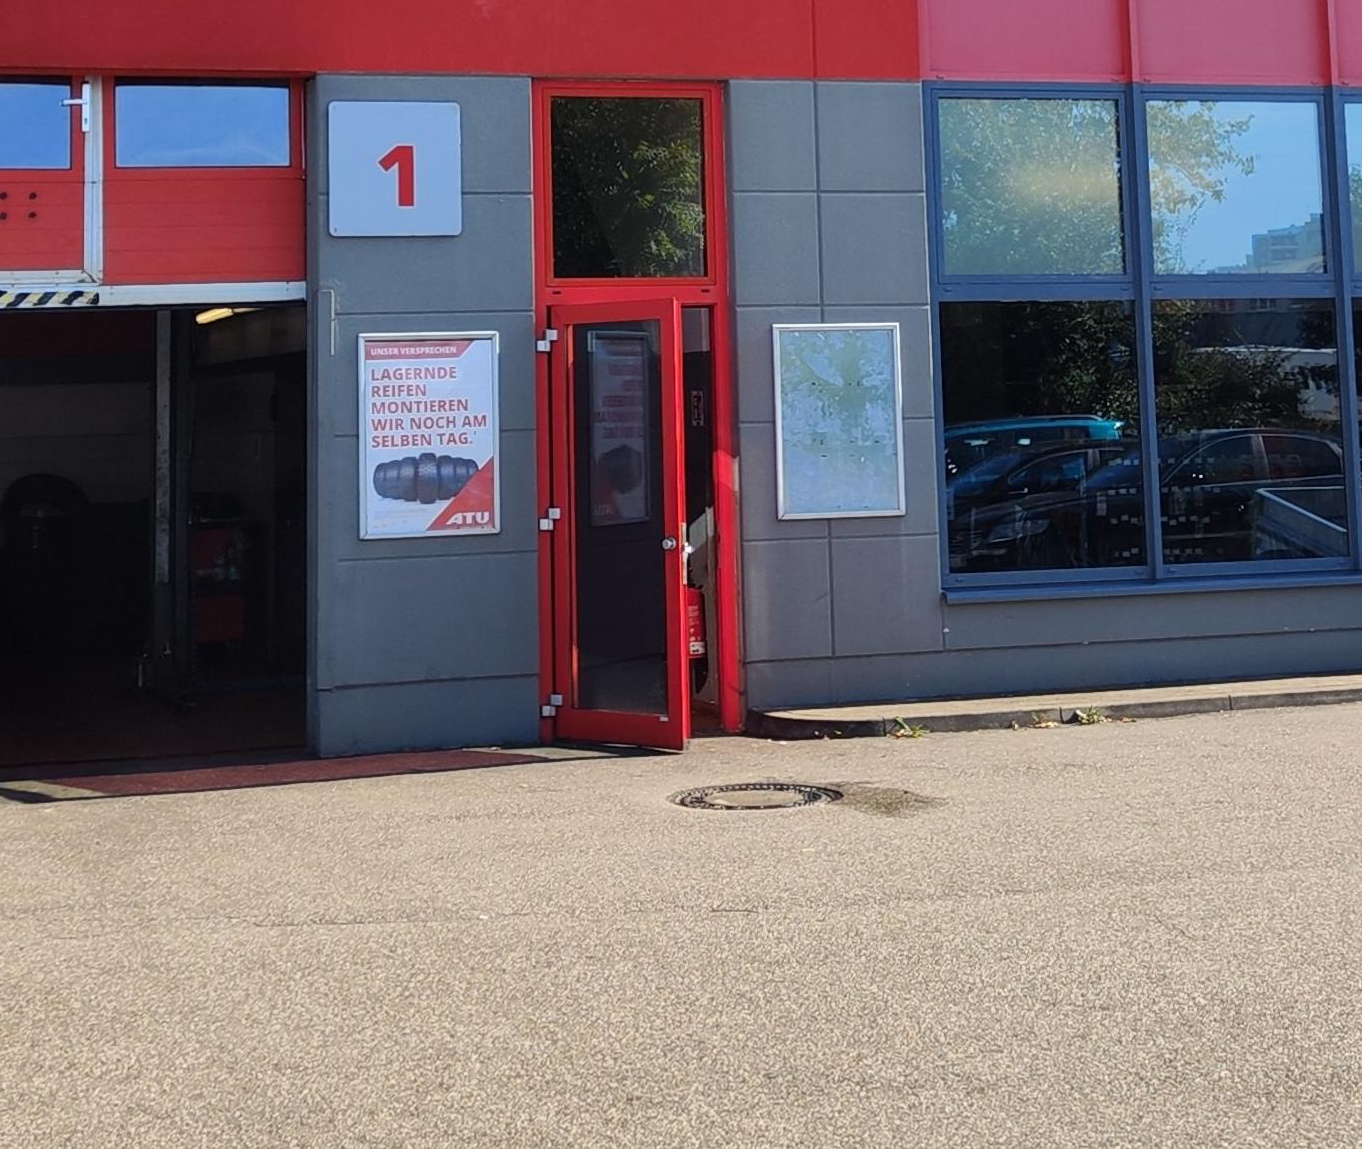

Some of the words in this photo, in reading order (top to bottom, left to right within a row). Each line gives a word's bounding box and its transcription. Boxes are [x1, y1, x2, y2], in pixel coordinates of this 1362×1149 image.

[377, 145, 416, 207] 1
[370, 347, 398, 356] UNSER
[400, 346, 457, 355] VERSPRECHEN
[371, 366, 457, 381] LAGERNDE
[371, 384, 427, 398] REIFEN
[371, 399, 469, 415] MONTIEREN
[371, 418, 405, 431] WIR
[409, 416, 456, 430] NOCH
[461, 414, 487, 428] AM
[371, 433, 432, 448] SELBEN
[446, 511, 490, 525] ATU
